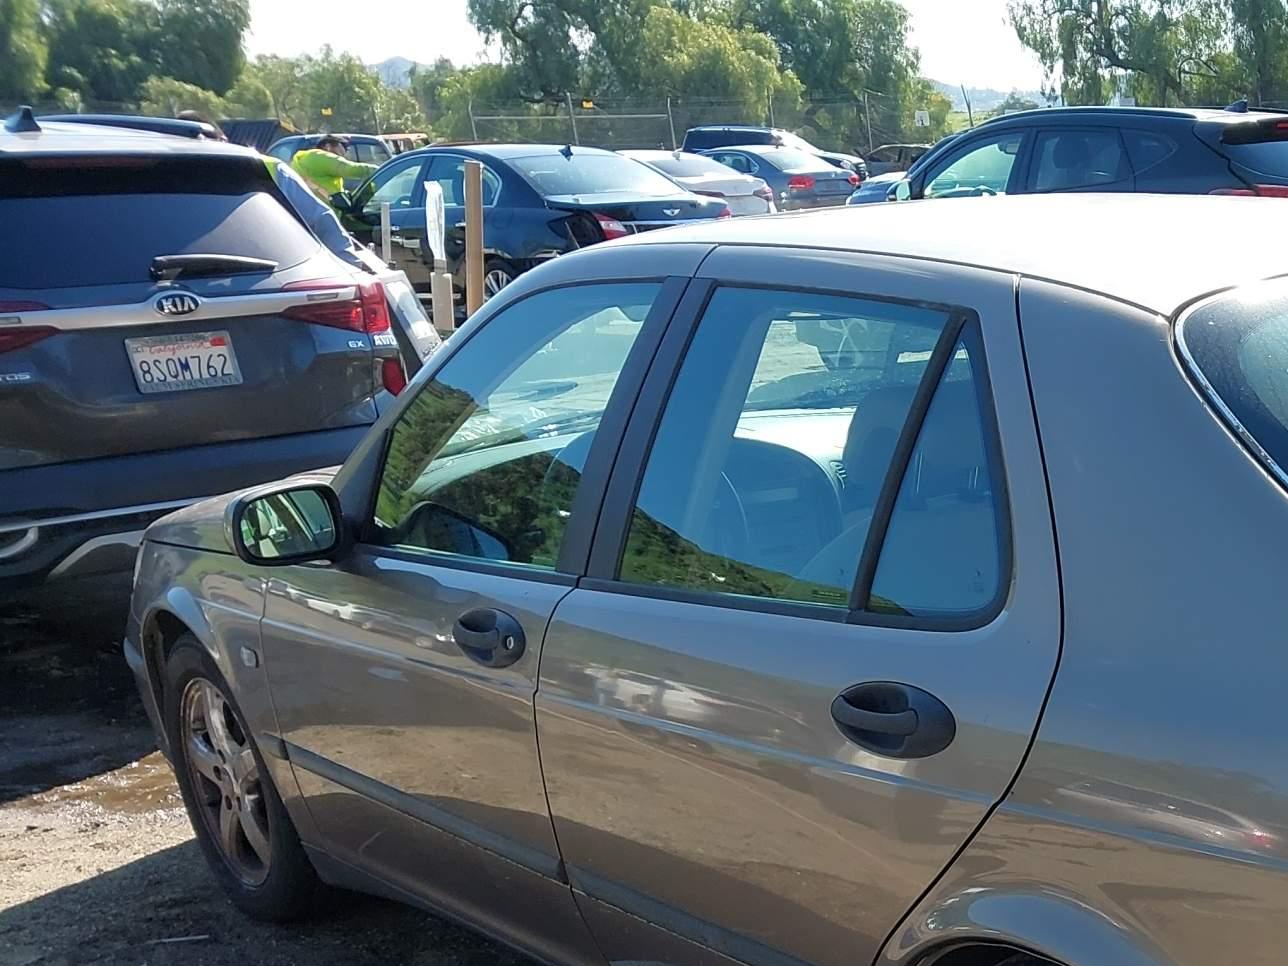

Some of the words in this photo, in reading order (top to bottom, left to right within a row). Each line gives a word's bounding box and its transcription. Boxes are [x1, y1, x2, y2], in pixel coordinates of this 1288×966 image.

[162, 297, 196, 313] KIA
[347, 340, 365, 348] EX
[374, 334, 397, 346] AWD
[148, 341, 210, 355] California
[139, 353, 233, 384] 8SQM762
